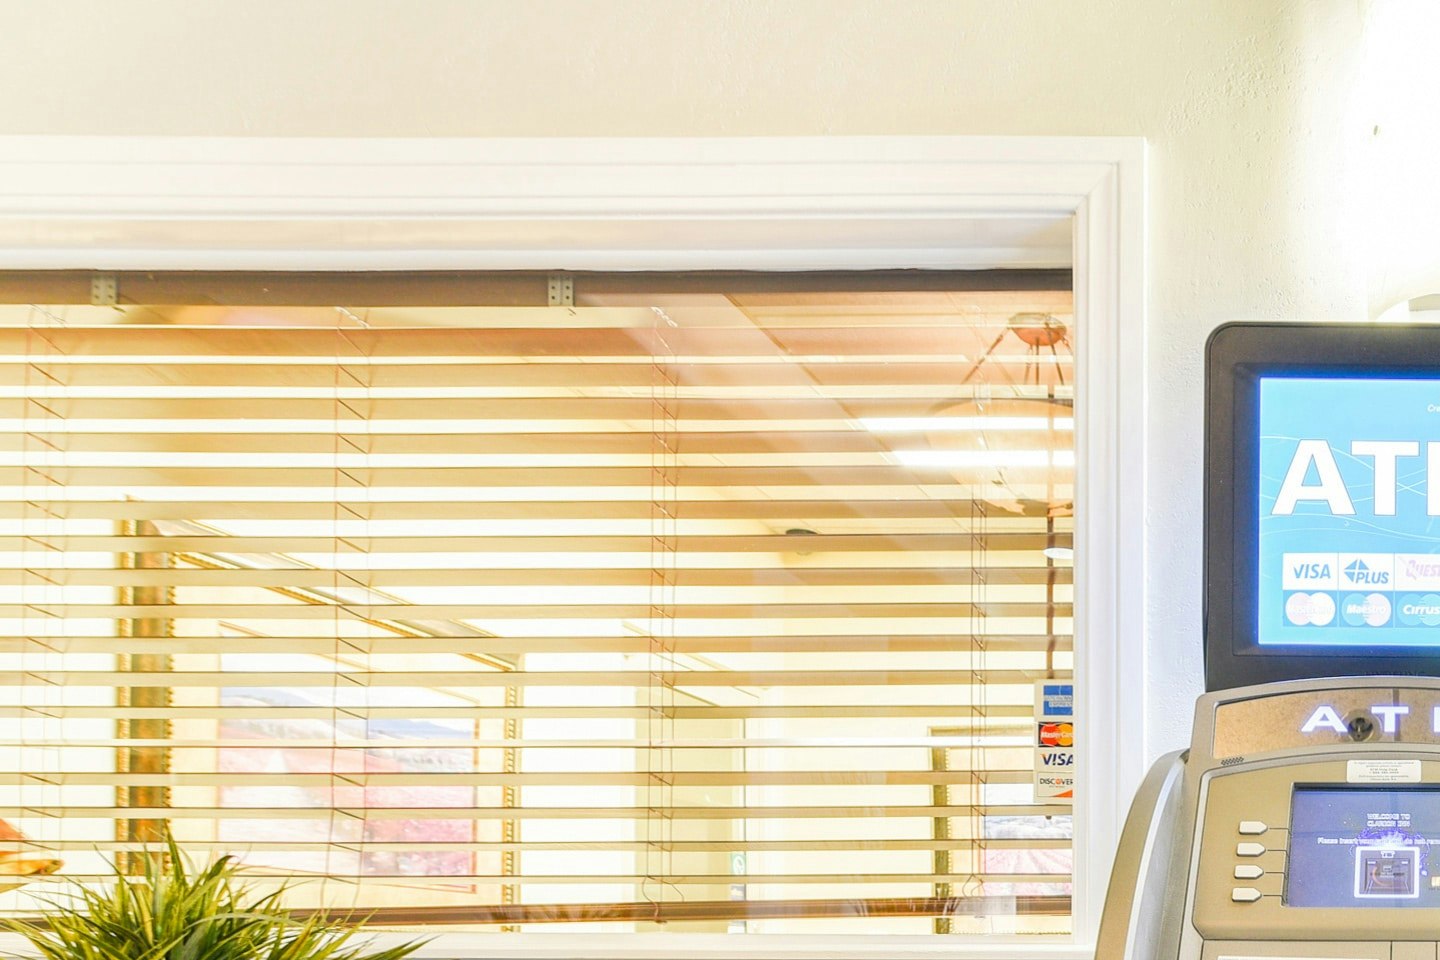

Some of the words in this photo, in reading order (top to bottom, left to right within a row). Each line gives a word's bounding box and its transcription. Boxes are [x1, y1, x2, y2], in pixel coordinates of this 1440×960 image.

[1293, 564, 1331, 579] VISA
[1355, 571, 1389, 584] PLUS
[1403, 604, 1440, 615] Cirrus
